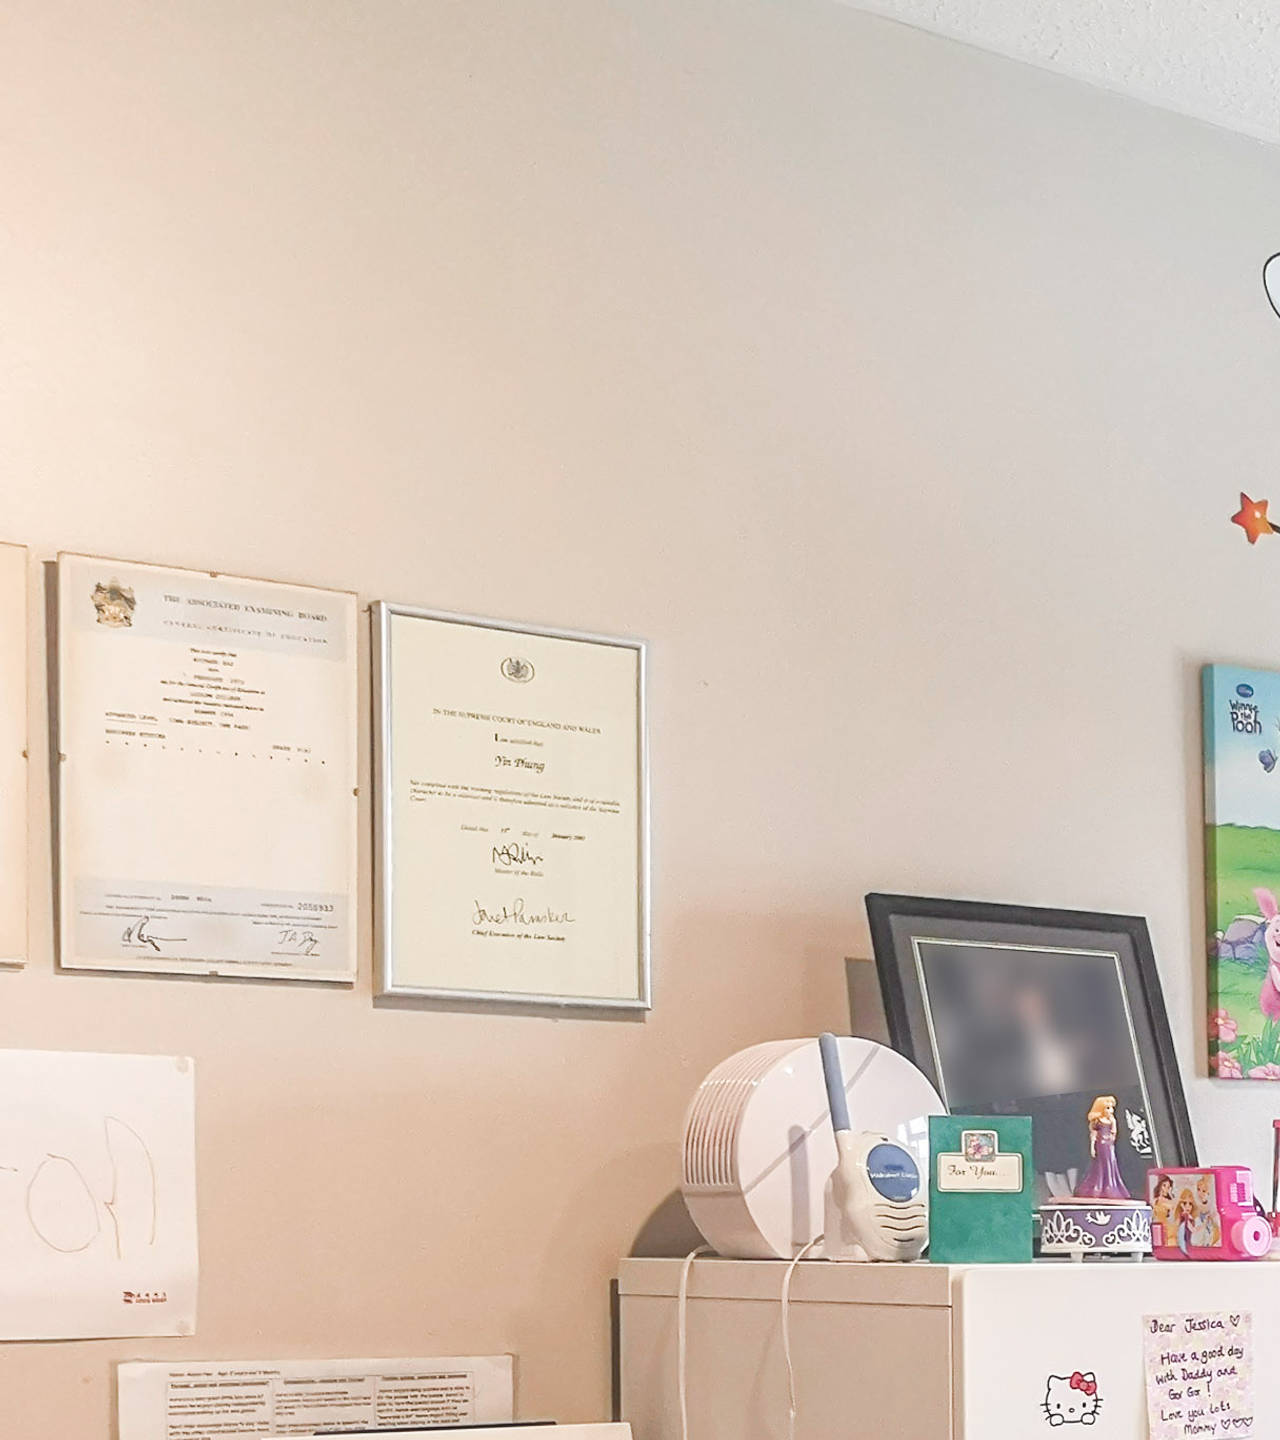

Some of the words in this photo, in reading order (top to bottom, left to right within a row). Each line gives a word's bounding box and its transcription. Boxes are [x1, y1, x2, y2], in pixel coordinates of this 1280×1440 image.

[1229, 699, 1258, 714] Winnie
[1230, 710, 1262, 735] Pooh
[947, 1164, 966, 1176] For
[1149, 1319, 1176, 1334] Dear
[1184, 1318, 1225, 1334] Jessica
[1160, 1351, 1188, 1366] Have
[1190, 1351, 1199, 1361] a
[1200, 1346, 1225, 1365] good
[1227, 1345, 1244, 1360] day
[1180, 1368, 1213, 1383] Daddy
[1216, 1366, 1238, 1377] and
[1160, 1409, 1184, 1422] Love
[1187, 1409, 1206, 1423] you
